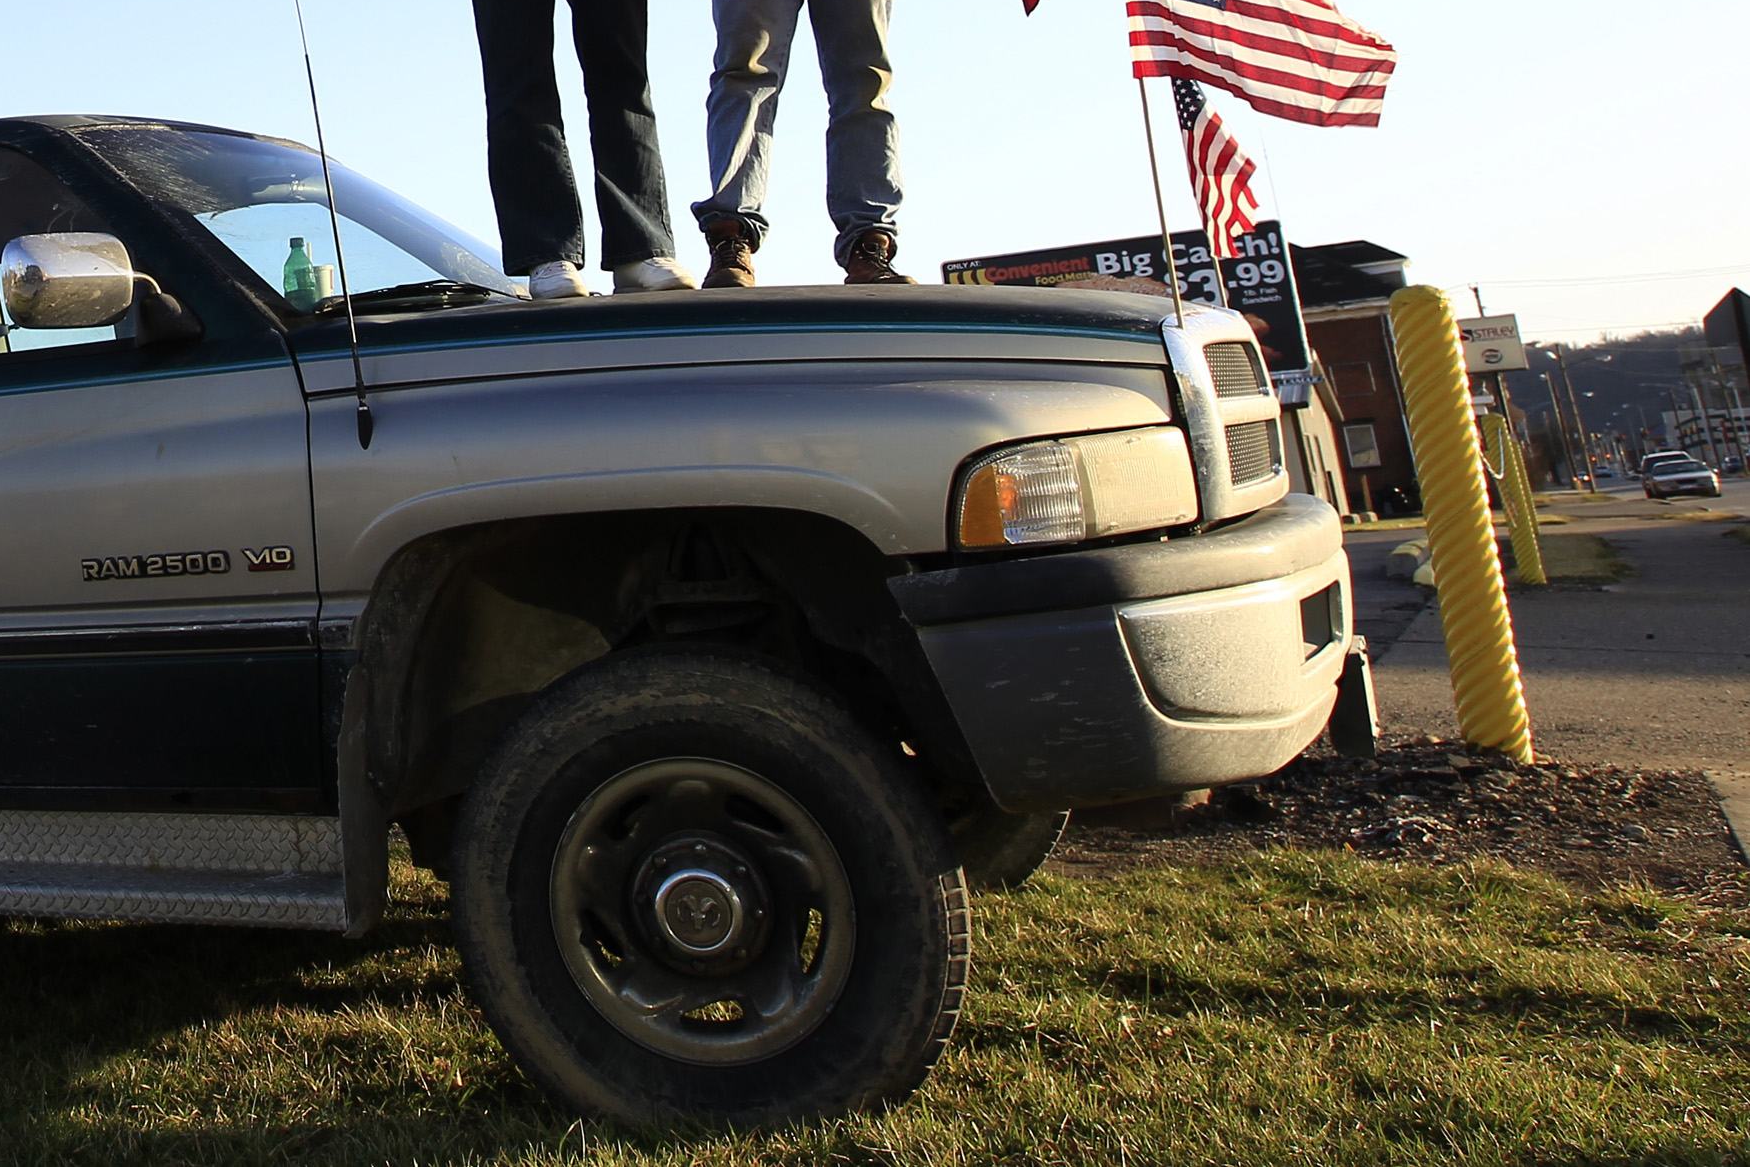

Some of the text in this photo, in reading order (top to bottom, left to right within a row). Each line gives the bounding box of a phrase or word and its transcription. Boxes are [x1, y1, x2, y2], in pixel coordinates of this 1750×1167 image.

[947, 262, 968, 271] ONLY
[985, 257, 1090, 282] Convenient
[1096, 251, 1154, 277] Big
[82, 558, 140, 580] RAM
[146, 552, 228, 575] 2500
